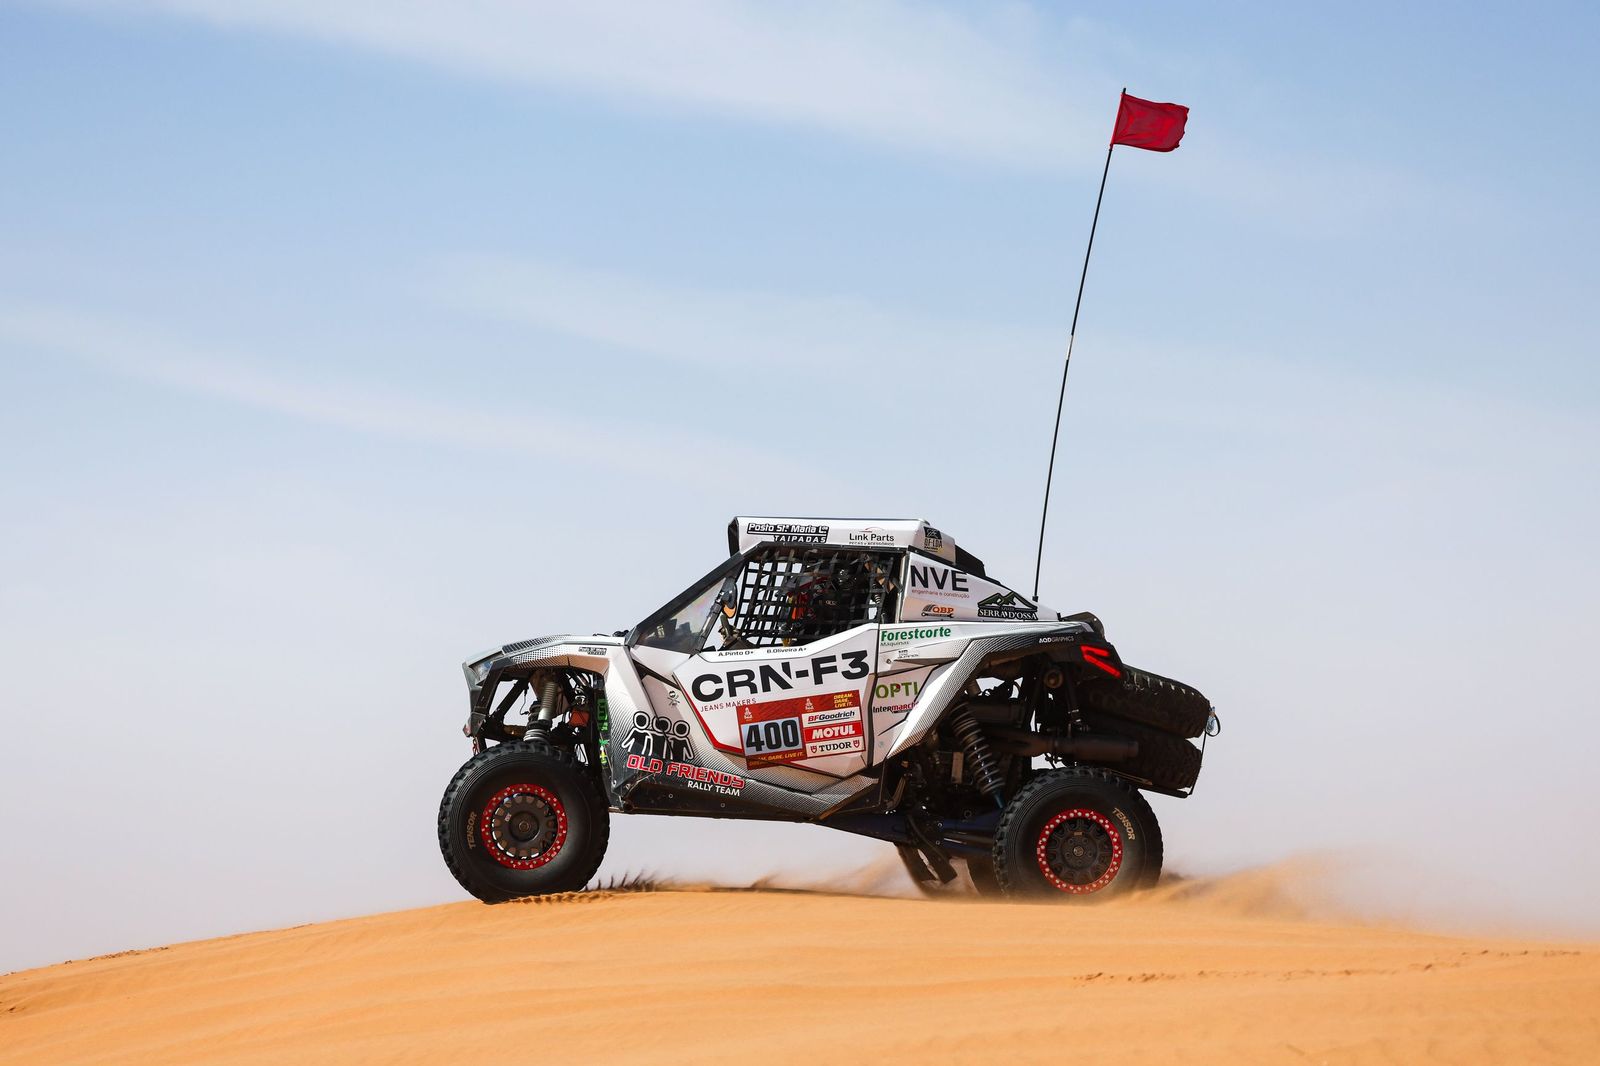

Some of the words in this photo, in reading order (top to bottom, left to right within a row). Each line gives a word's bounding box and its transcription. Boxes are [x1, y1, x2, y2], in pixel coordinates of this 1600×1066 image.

[748, 523, 774, 532] Posto
[791, 525, 816, 534] Maria
[774, 535, 827, 543] TAIPADAS
[849, 532, 869, 541] Link
[870, 533, 895, 542] Parts
[910, 564, 969, 592] NVE
[979, 608, 1007, 618] SERRA
[1008, 611, 1037, 621] D'OSSA
[881, 626, 952, 642] Forestcorte
[691, 650, 870, 702] CRN-F3
[875, 681, 919, 699] OPTI
[700, 702, 725, 713] JEANS
[725, 698, 757, 709] MAKERS
[807, 710, 856, 723] BFGoodrich
[745, 719, 800, 752] 400
[811, 724, 856, 740] MOTUL
[818, 741, 852, 753] TUDOR
[626, 754, 663, 774] OLD
[666, 761, 746, 789] FRIENDS
[687, 781, 714, 792] RALLY
[715, 785, 741, 797] TEAM
[466, 811, 478, 850] TENSOR
[1112, 807, 1136, 841] TENSOR
